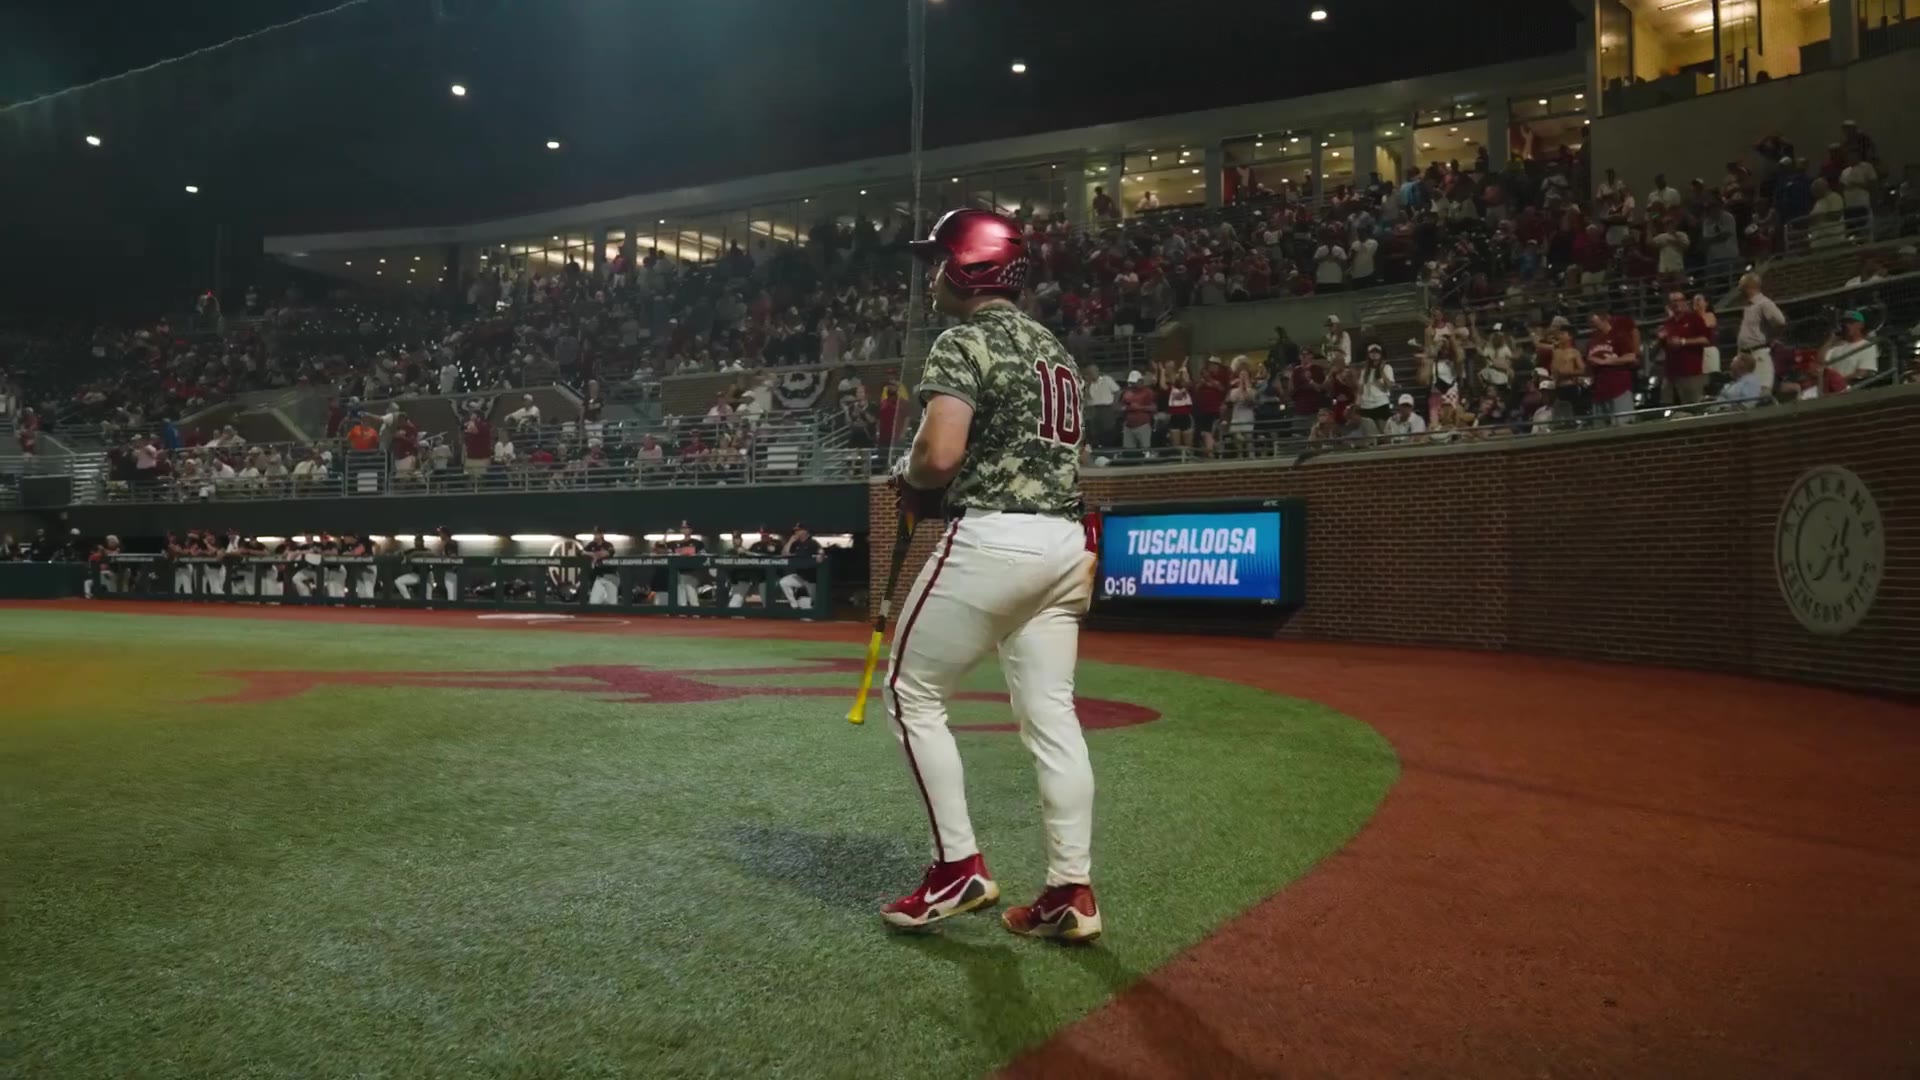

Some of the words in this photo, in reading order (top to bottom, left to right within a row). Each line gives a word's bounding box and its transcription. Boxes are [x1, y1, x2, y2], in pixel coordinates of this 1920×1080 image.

[1034, 358, 1082, 447] 10
[1128, 527, 1257, 555] TUSCALOOSA
[1105, 576, 1137, 595] 0:16
[1141, 559, 1240, 585] REGIONAL
